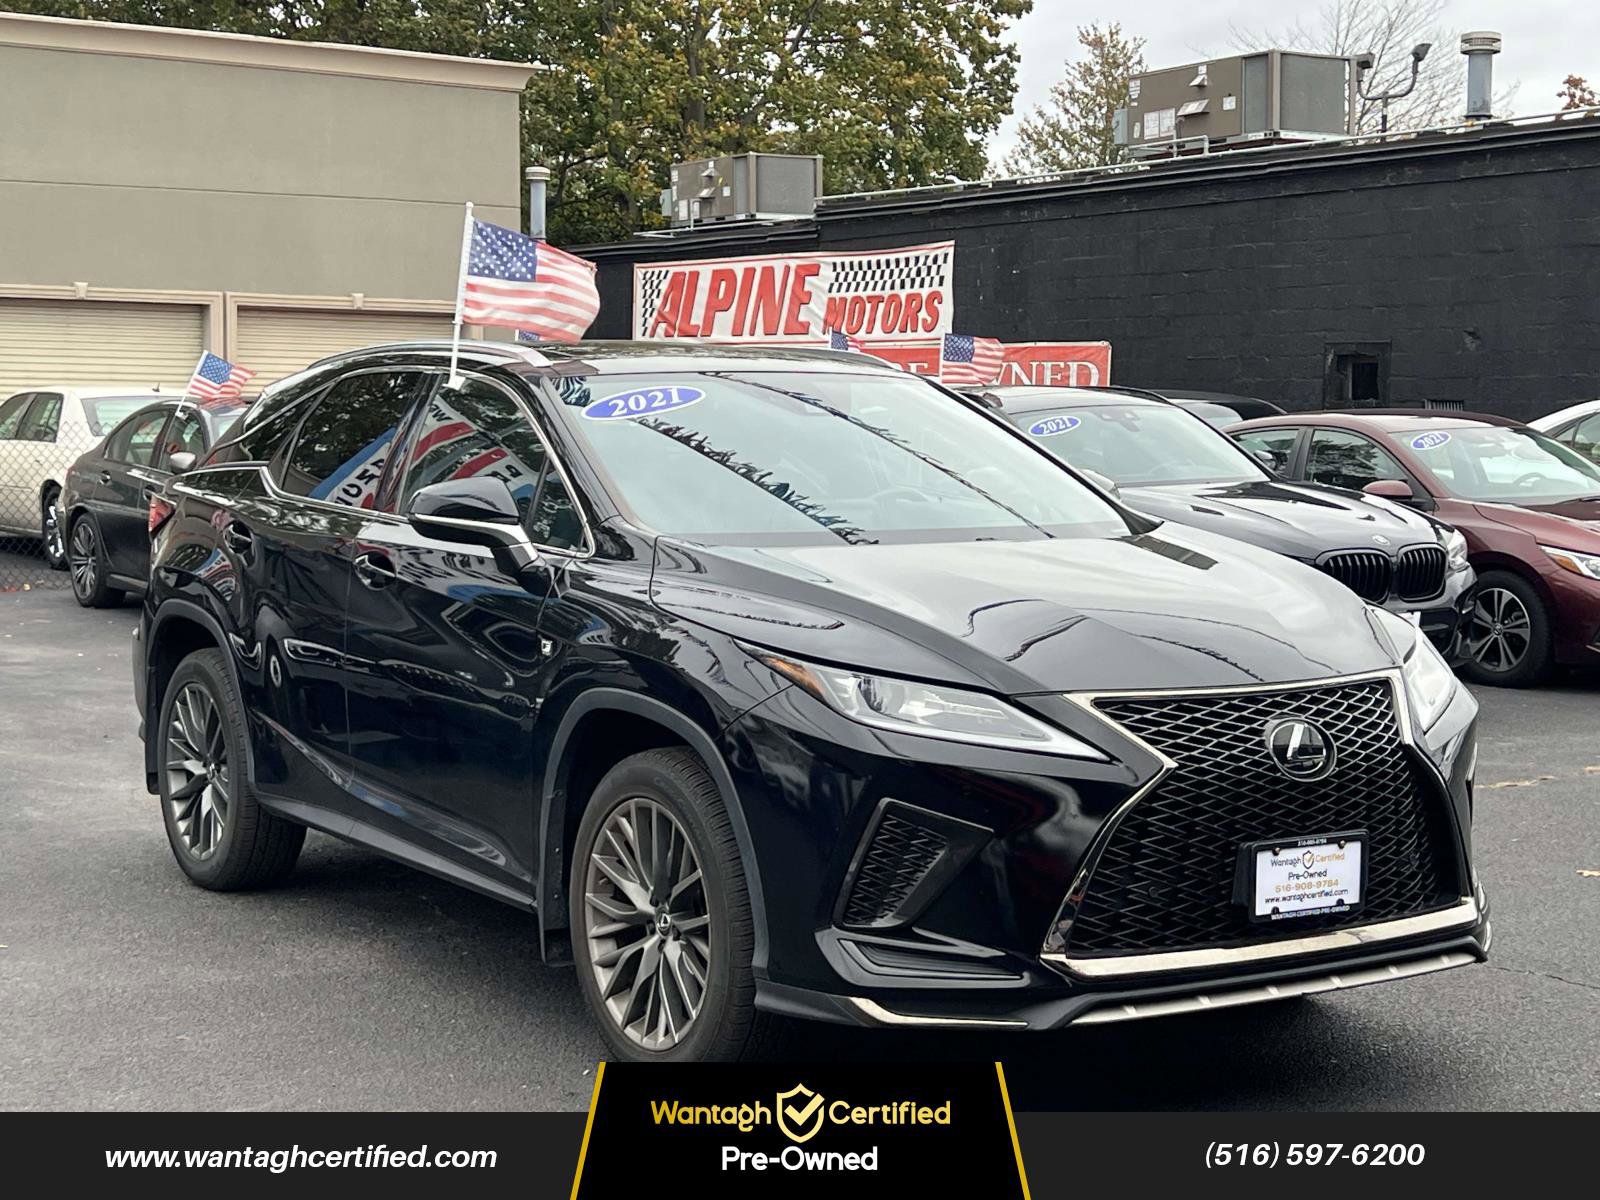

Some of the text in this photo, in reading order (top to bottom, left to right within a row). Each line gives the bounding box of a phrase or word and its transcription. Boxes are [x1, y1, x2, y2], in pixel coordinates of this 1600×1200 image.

[649, 263, 944, 337] ALPINE MOTORS
[608, 387, 682, 417] 2021
[1038, 416, 1072, 435] 2021
[1270, 853, 1345, 868] Wantagh Certified
[1288, 869, 1328, 881] Pre-Owned
[1275, 879, 1339, 893] 516-908-9784
